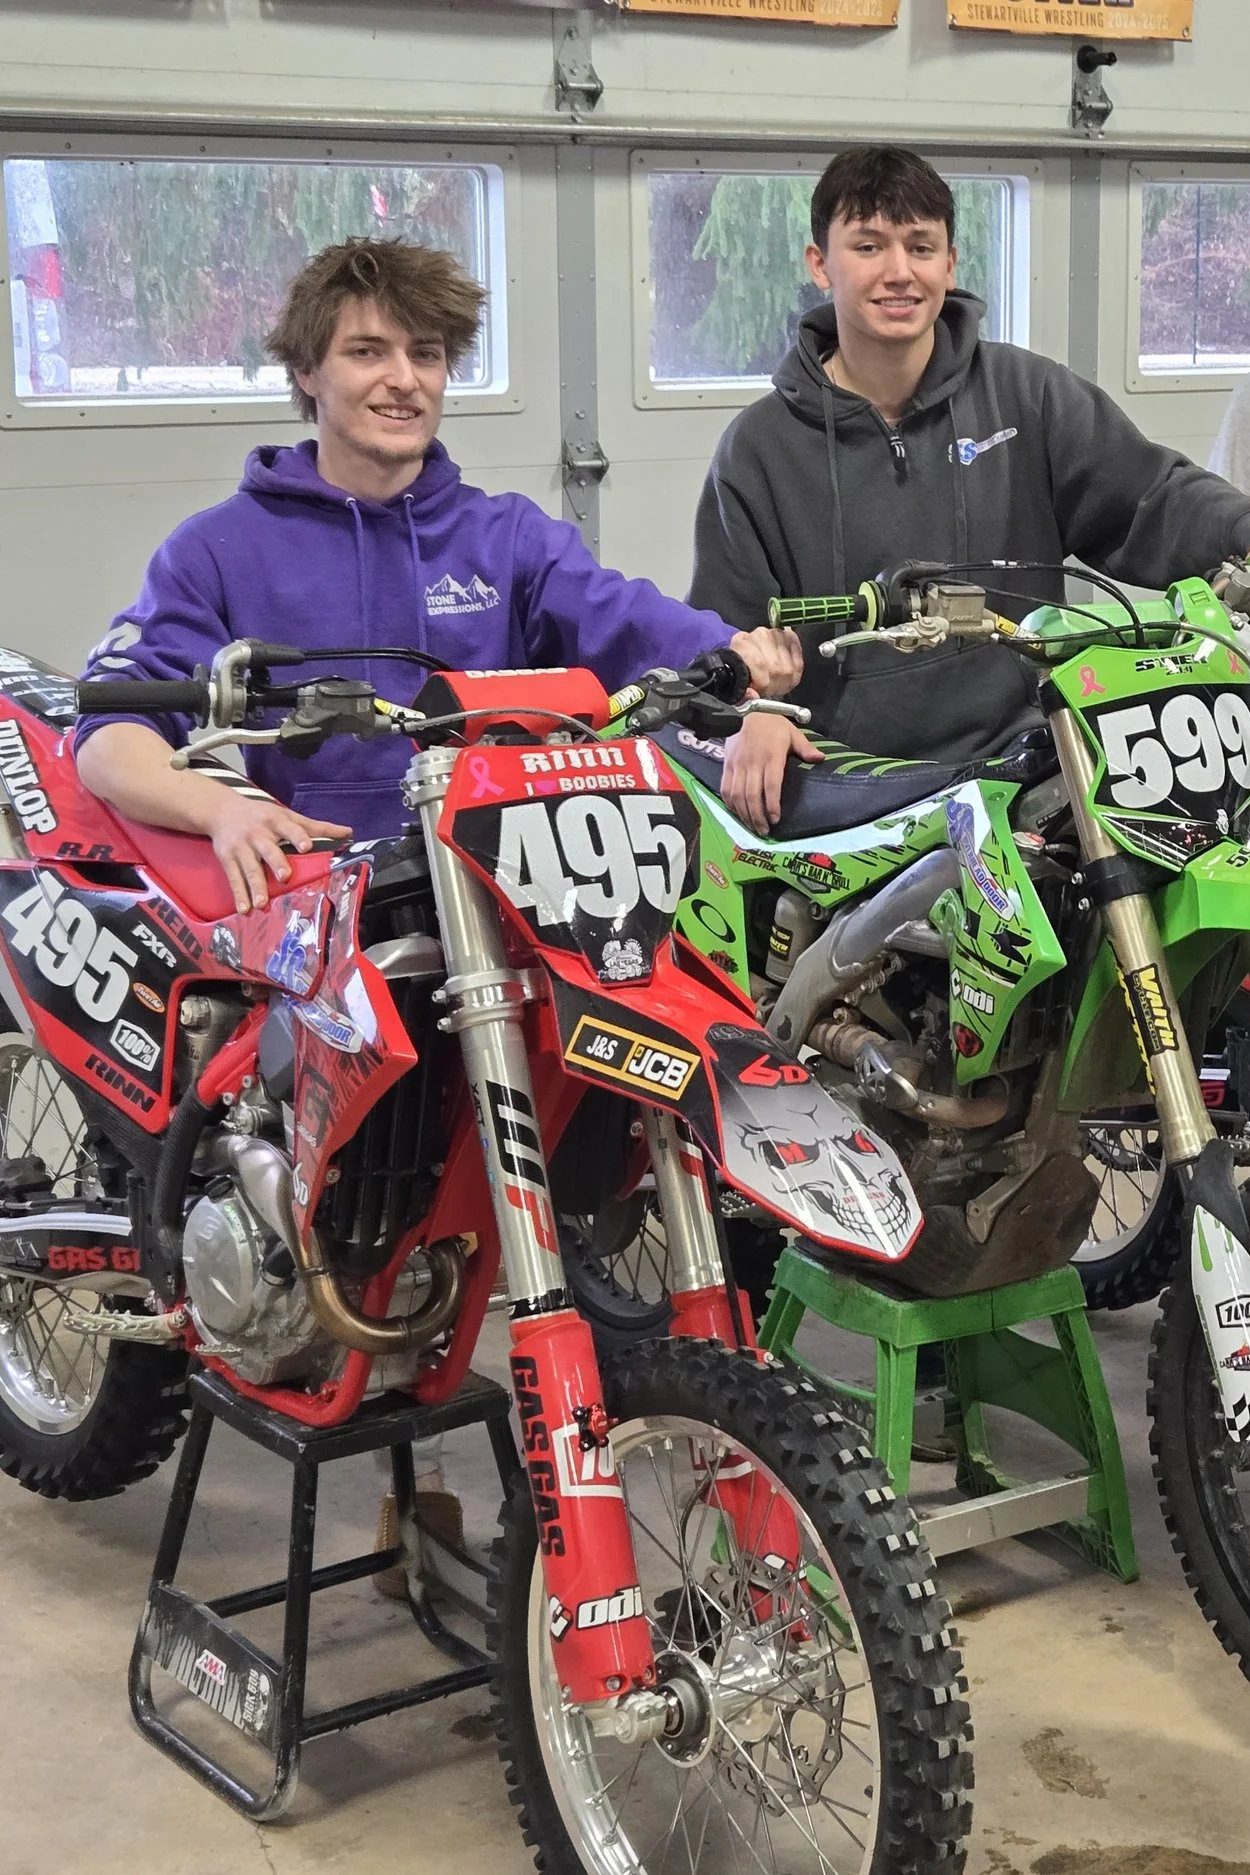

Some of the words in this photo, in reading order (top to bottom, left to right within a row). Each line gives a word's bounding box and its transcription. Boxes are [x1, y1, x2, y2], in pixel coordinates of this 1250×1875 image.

[967, 3, 1040, 25] STEWARTVILLE
[1043, 9, 1104, 29] WRESTLING
[1107, 13, 1169, 31] 2024-2025
[427, 594, 456, 606] STONE
[485, 598, 499, 609] LLC
[677, 728, 725, 763] GUTS
[0, 719, 57, 834] DUNLOP
[558, 773, 636, 793] BOOBIES
[495, 794, 687, 927] 495
[983, 880, 1007, 914] DOOR
[2, 870, 139, 1023] 495
[131, 920, 178, 969] FXR
[1138, 966, 1176, 1048] VAITH
[118, 1028, 154, 1065] 100%
[586, 1034, 618, 1061] J&S
[629, 1046, 690, 1090] JCB
[84, 1054, 156, 1114] RINN
[48, 1245, 108, 1271] GAS
[198, 1653, 227, 1682] AMA
